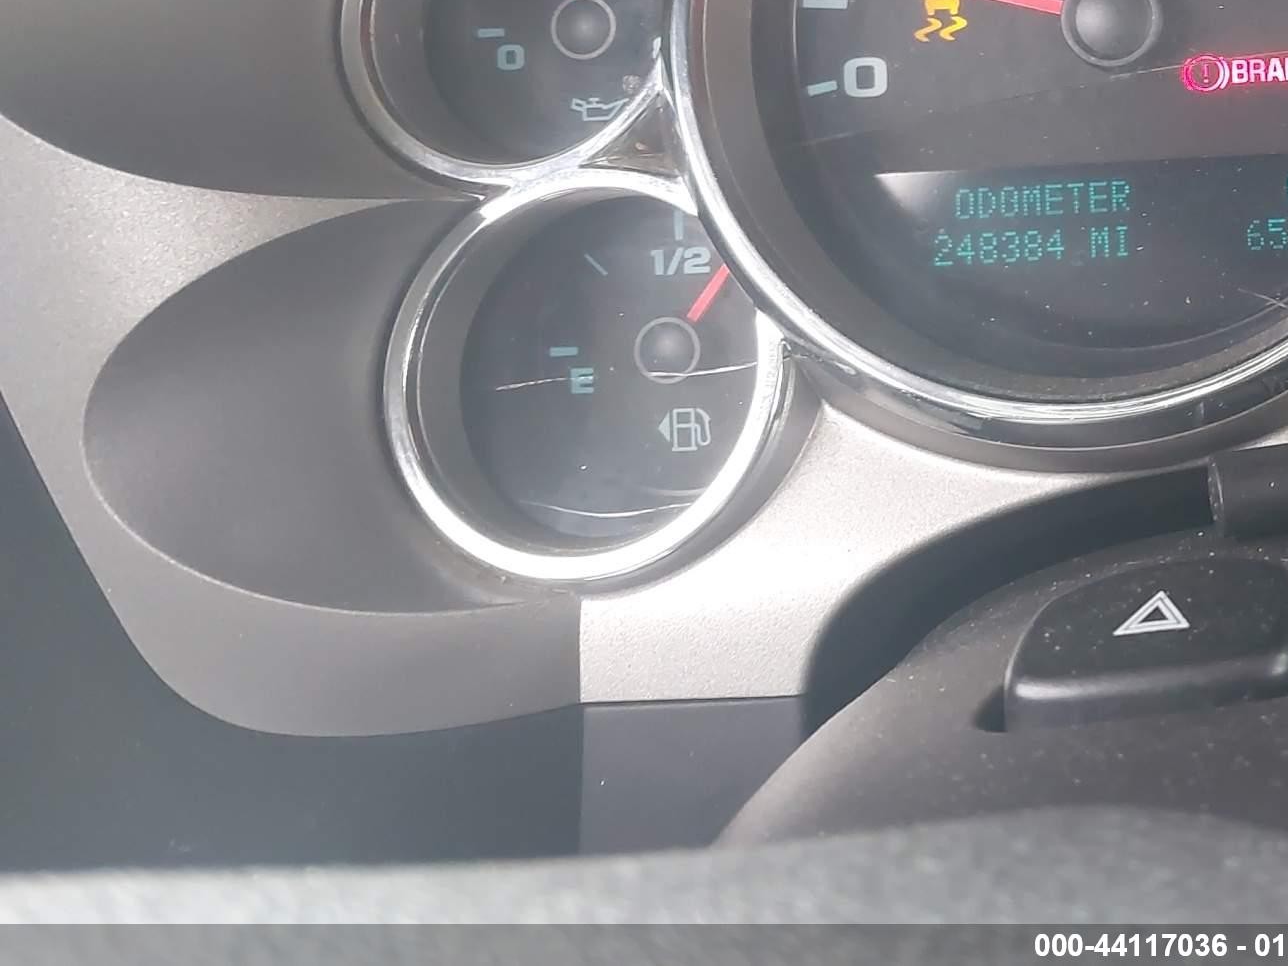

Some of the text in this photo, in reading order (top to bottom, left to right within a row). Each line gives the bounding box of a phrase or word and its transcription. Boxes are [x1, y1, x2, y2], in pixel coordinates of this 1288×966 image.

[497, 44, 525, 70] 0
[843, 57, 888, 97] 0
[954, 179, 1130, 220] ODOMETER
[650, 246, 711, 276] 1/2
[933, 225, 1129, 266] 248384 MI
[570, 367, 594, 393] E
